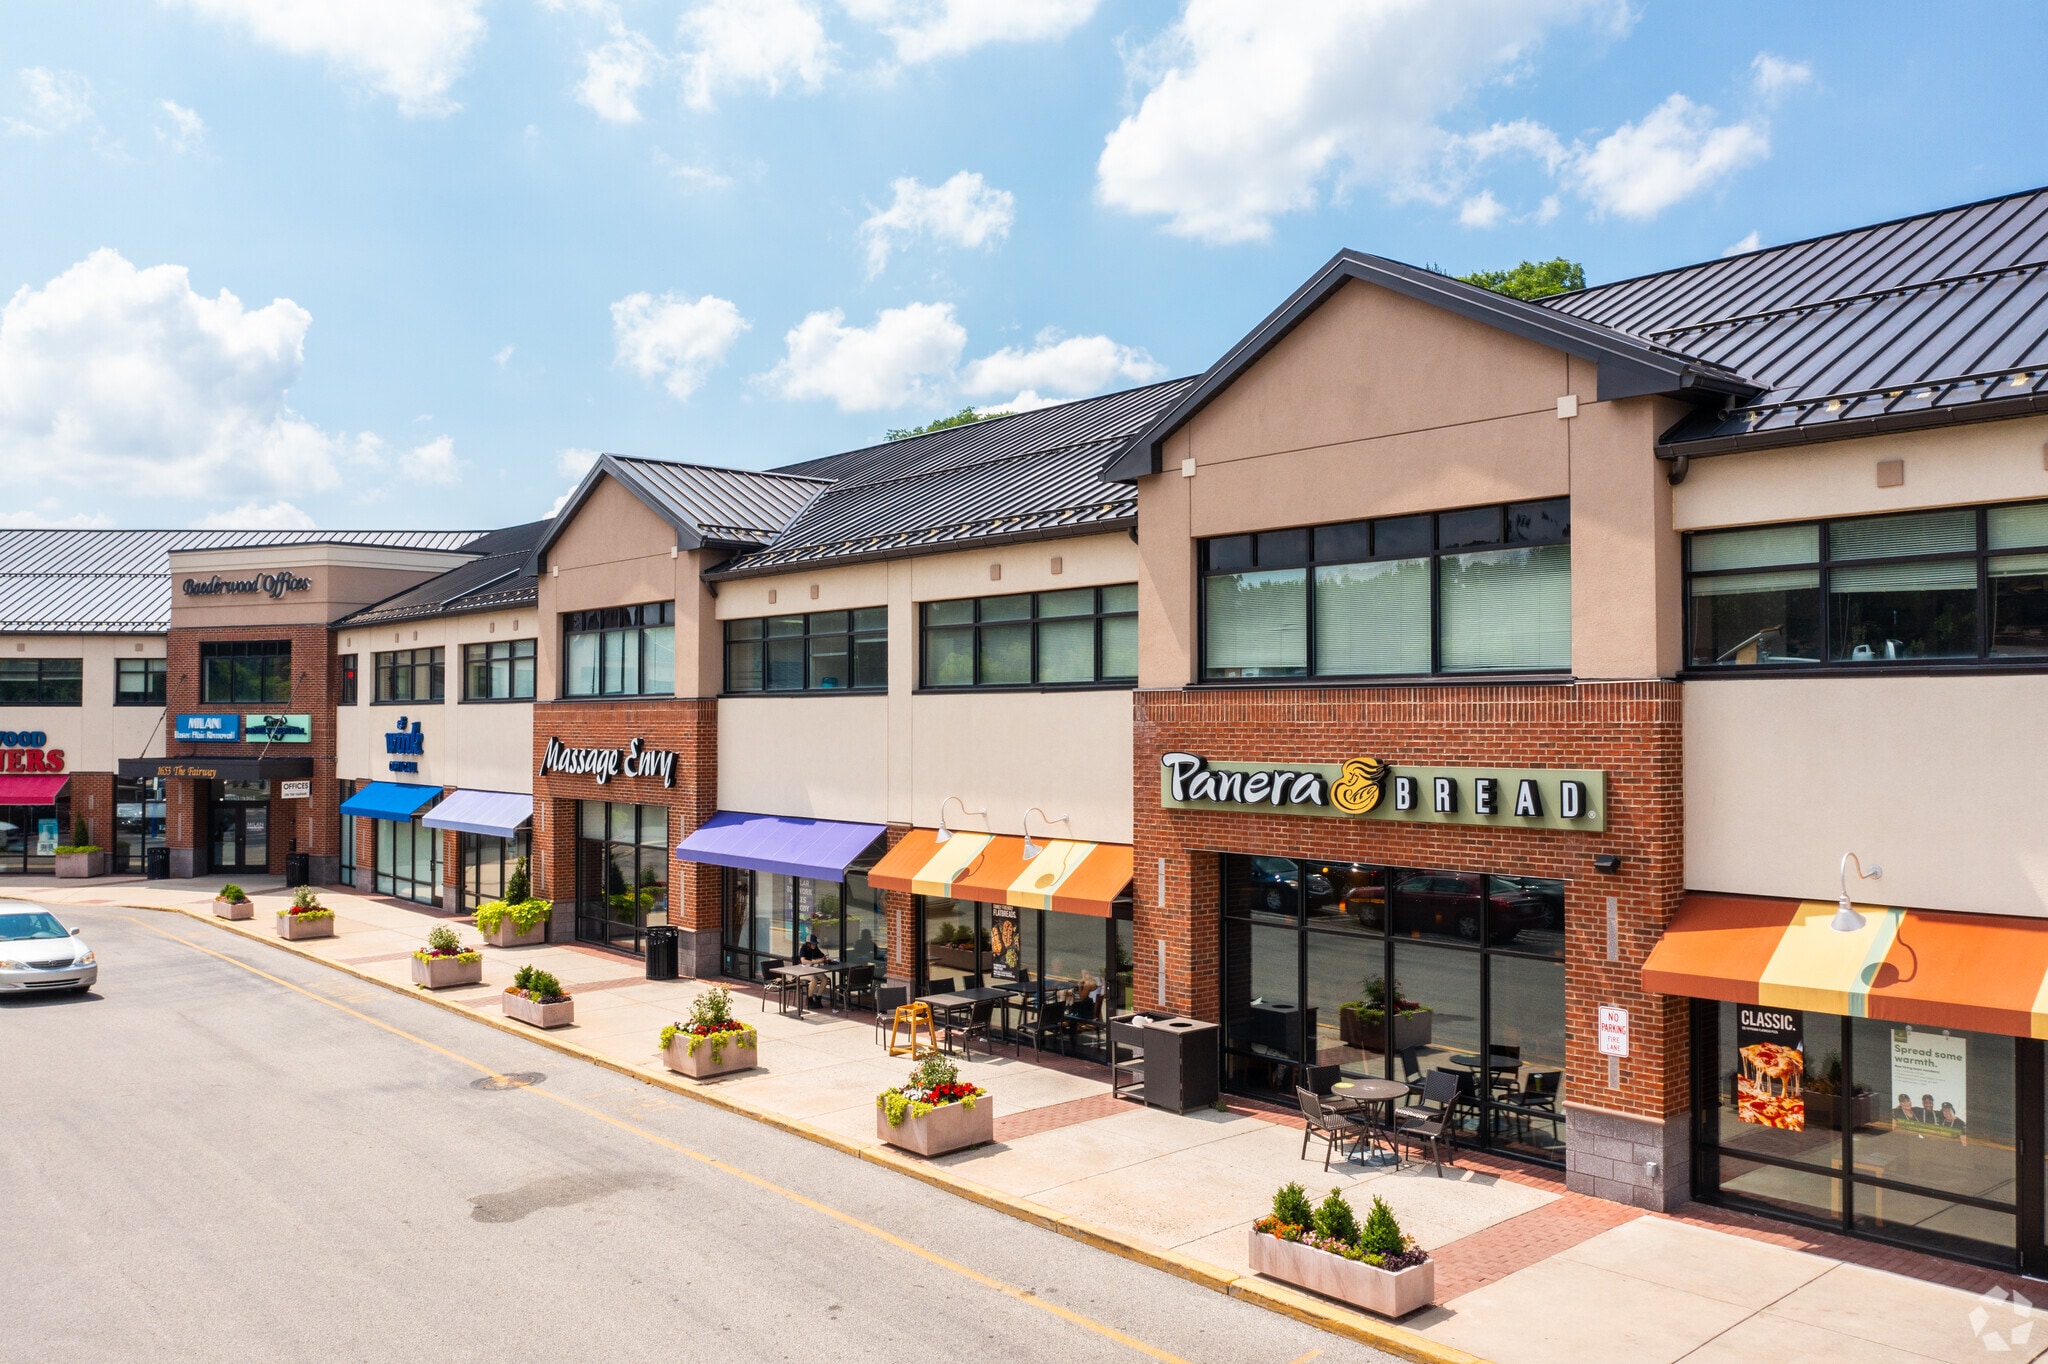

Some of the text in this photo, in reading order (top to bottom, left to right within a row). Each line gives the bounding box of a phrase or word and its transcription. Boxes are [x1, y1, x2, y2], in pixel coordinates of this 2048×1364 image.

[182, 571, 311, 599] Baederwood Offices
[188, 717, 222, 729] MILAN
[174, 730, 235, 739] Laser Hair Removal
[385, 721, 425, 755] wink
[539, 736, 679, 788] Massage Envy
[157, 765, 217, 780] 1653 The Fairway
[283, 782, 309, 790] OFFICES
[1161, 752, 1586, 818] Panera BREAD
[1608, 1012, 1619, 1022] NO
[1741, 1009, 1796, 1031] CLASSIC.
[1601, 1022, 1626, 1035] PARKING
[1894, 1044, 1963, 1061] Spread some
[1894, 1056, 1938, 1068] warmth.
